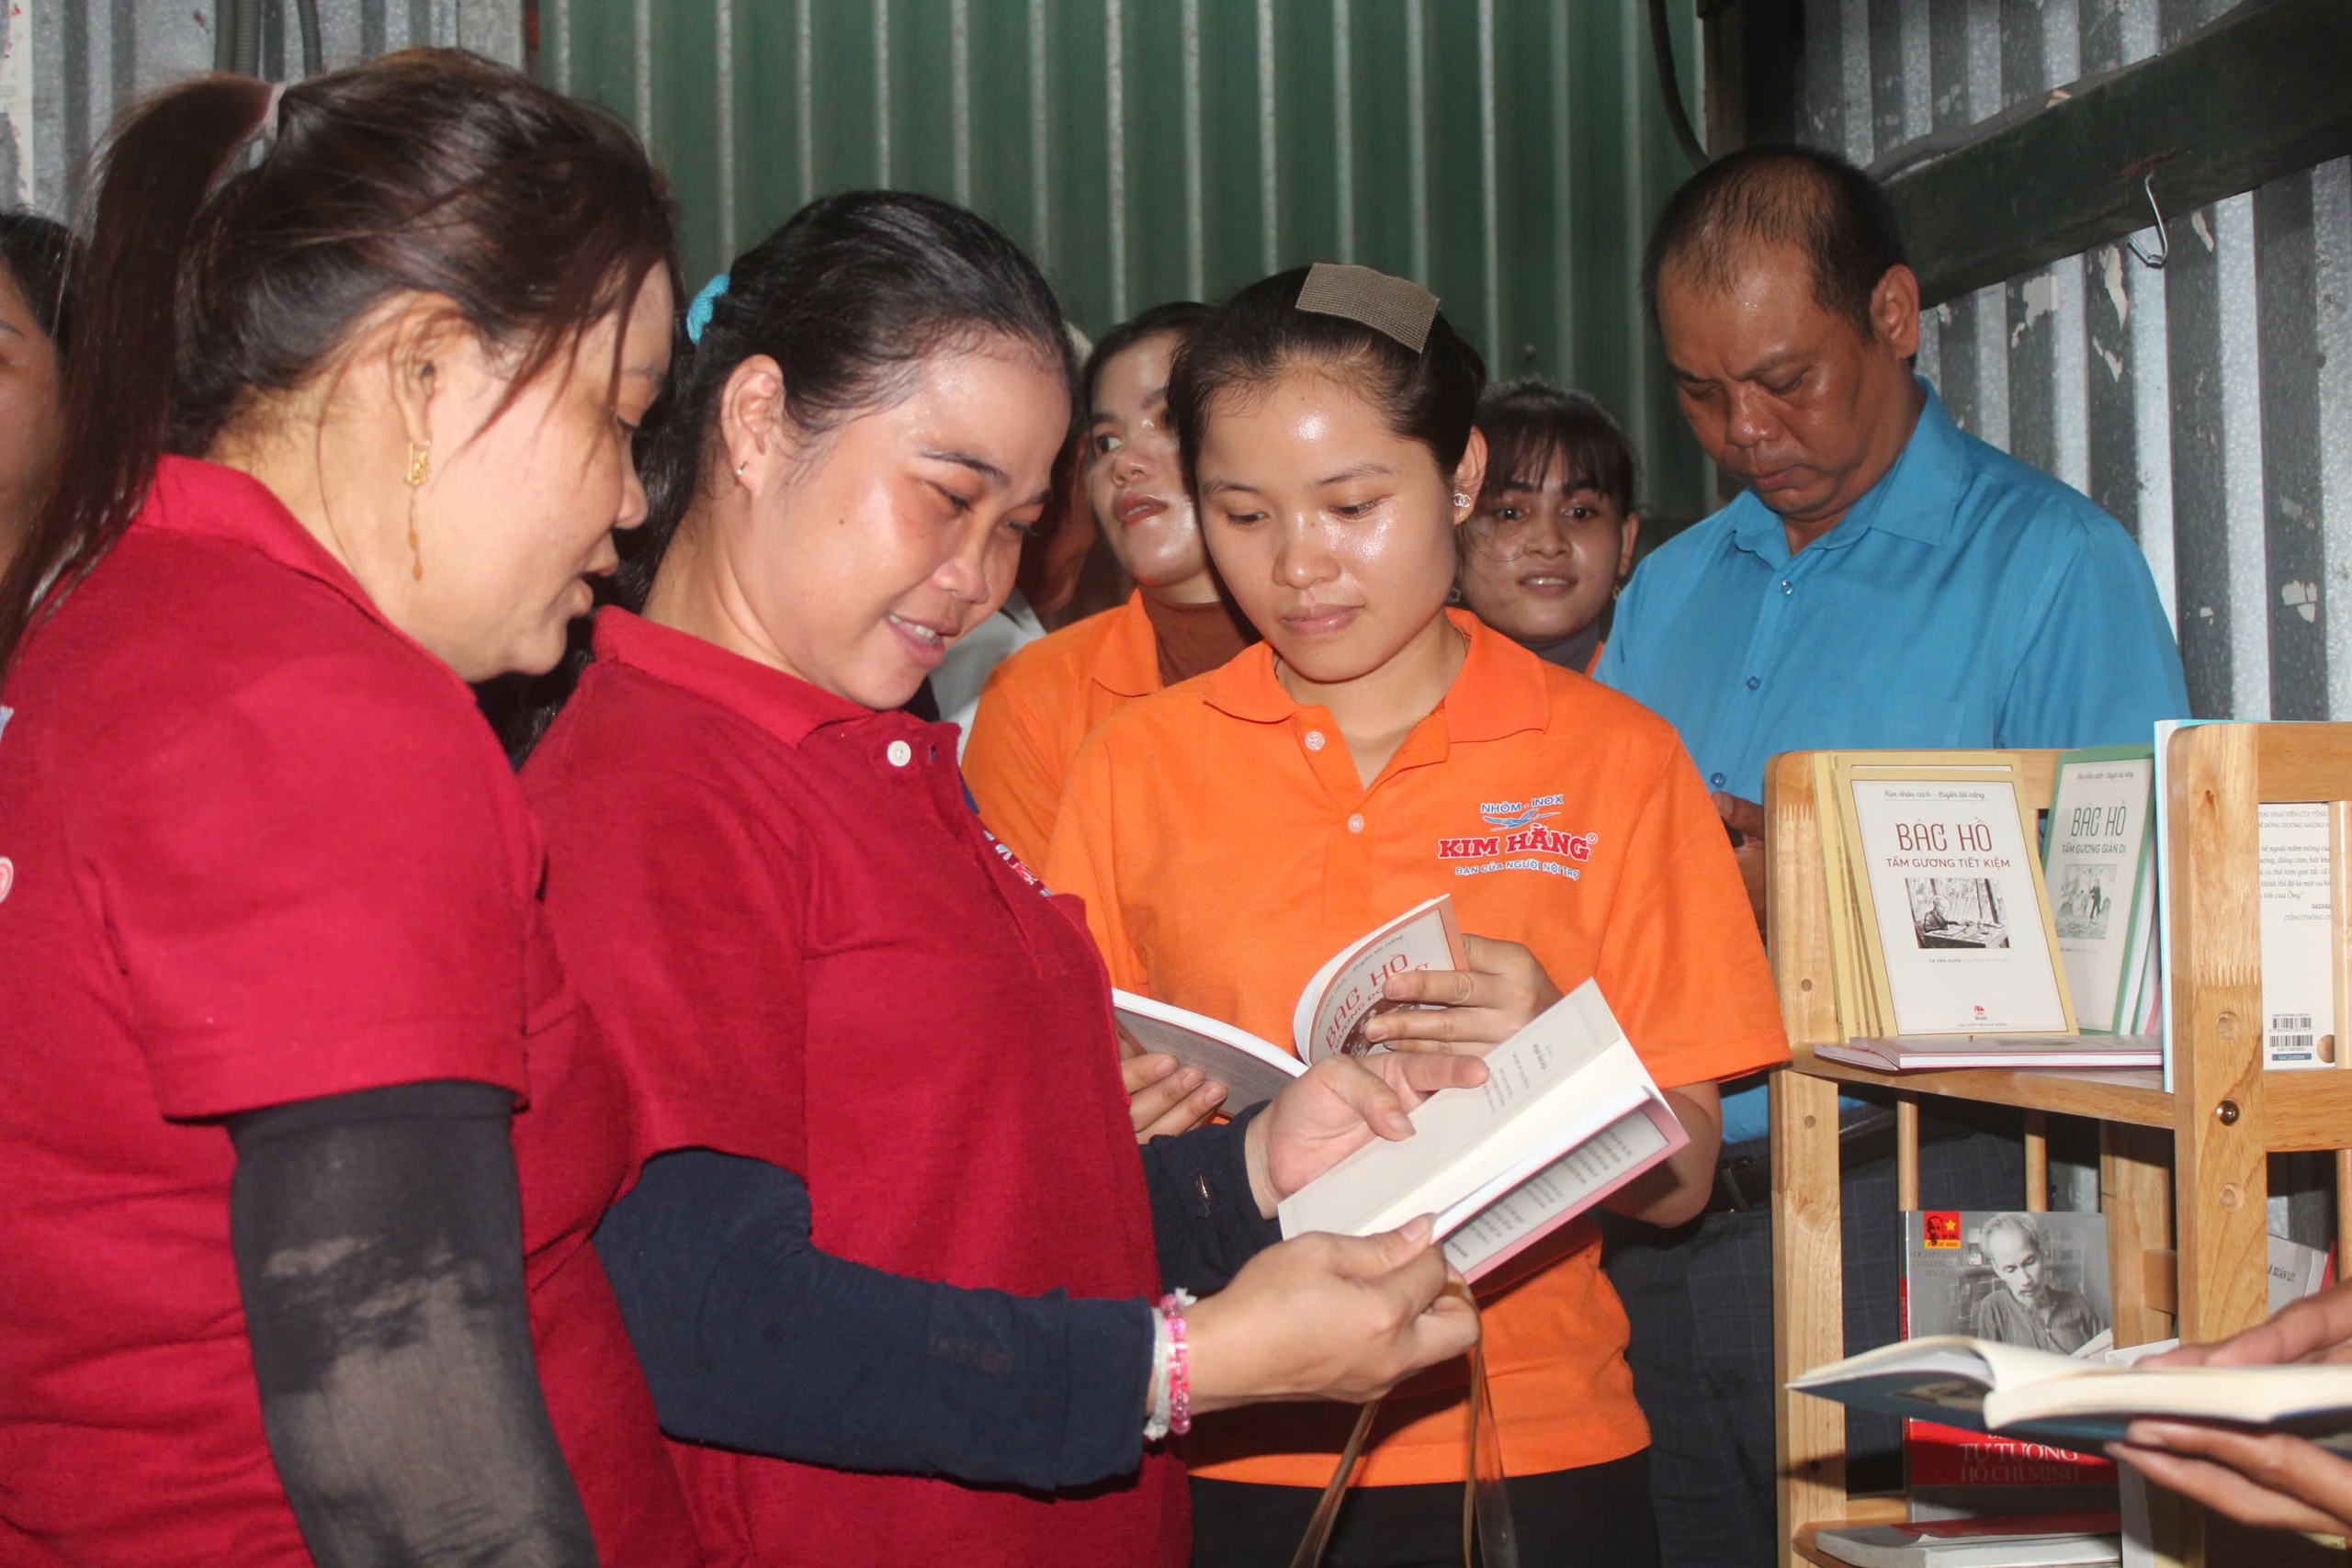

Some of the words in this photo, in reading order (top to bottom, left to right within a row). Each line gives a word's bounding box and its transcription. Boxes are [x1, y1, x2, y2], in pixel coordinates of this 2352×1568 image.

[1480, 801, 1521, 814] NHÔM
[1531, 794, 1564, 807] INOX
[1895, 818, 1948, 852] BÁC
[1956, 816, 1993, 852] HỒ
[1438, 837, 1500, 859] KIM
[1454, 865, 1479, 876] BẠN
[1481, 862, 1504, 872] CỦA
[1505, 858, 1541, 871] NGƯỜI
[1543, 862, 1562, 874] NỘI
[1886, 855, 1910, 868] TẤM
[1912, 857, 1956, 868] GƯƠNG
[1958, 856, 1980, 868] TIẾT
[1984, 856, 2011, 871] KIỆM
[2029, 1465, 2081, 1482] MINH
